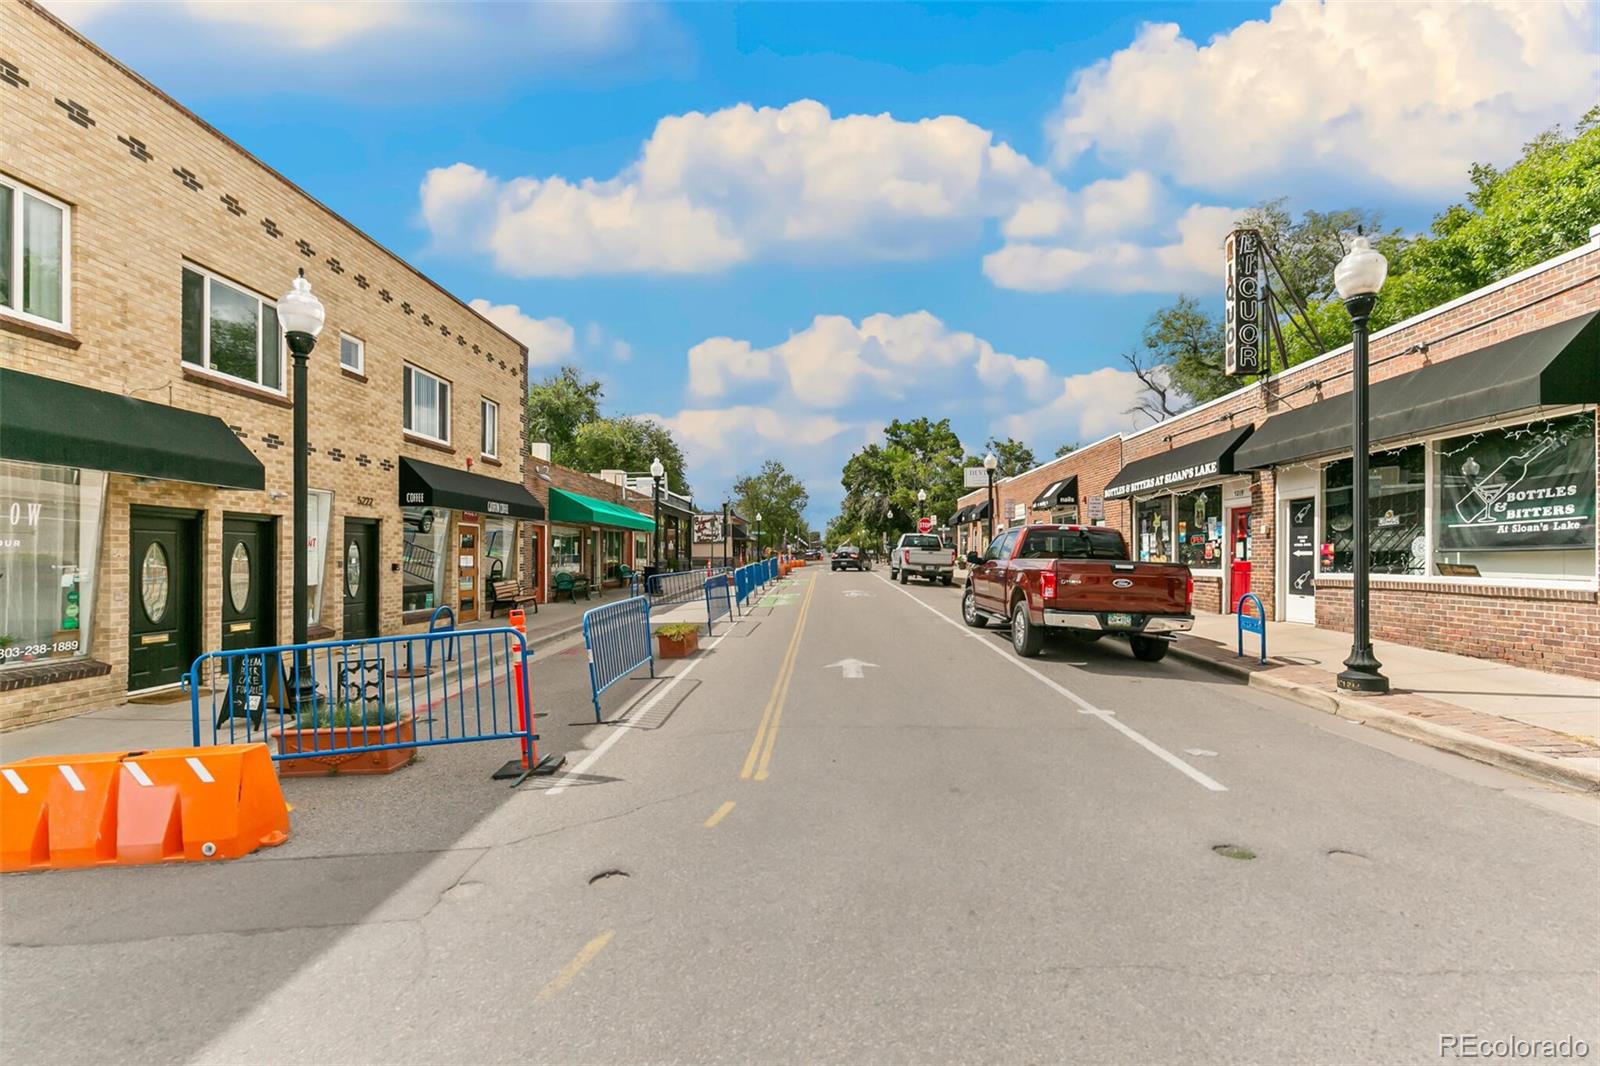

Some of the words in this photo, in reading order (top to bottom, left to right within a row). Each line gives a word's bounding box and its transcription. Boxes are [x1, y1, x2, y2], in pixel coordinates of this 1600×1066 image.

[1239, 234, 1258, 368] LIQUOR
[1104, 487, 1126, 498] BOTTLES
[1125, 485, 1131, 493] &
[1130, 478, 1155, 492] BITTERS
[1154, 475, 1164, 487] AT
[1164, 468, 1194, 484] SLOAN'S
[1194, 461, 1217, 477] LAKE
[406, 492, 424, 503] COFFEE
[1506, 485, 1577, 502] BOTTLES
[1493, 502, 1507, 512] &
[1506, 504, 1575, 519] BITTERS
[1496, 525, 1508, 533] At
[1511, 523, 1549, 533] Sloan's
[1552, 521, 1580, 530] Lake
[1190, 535, 1204, 544] OPEN
